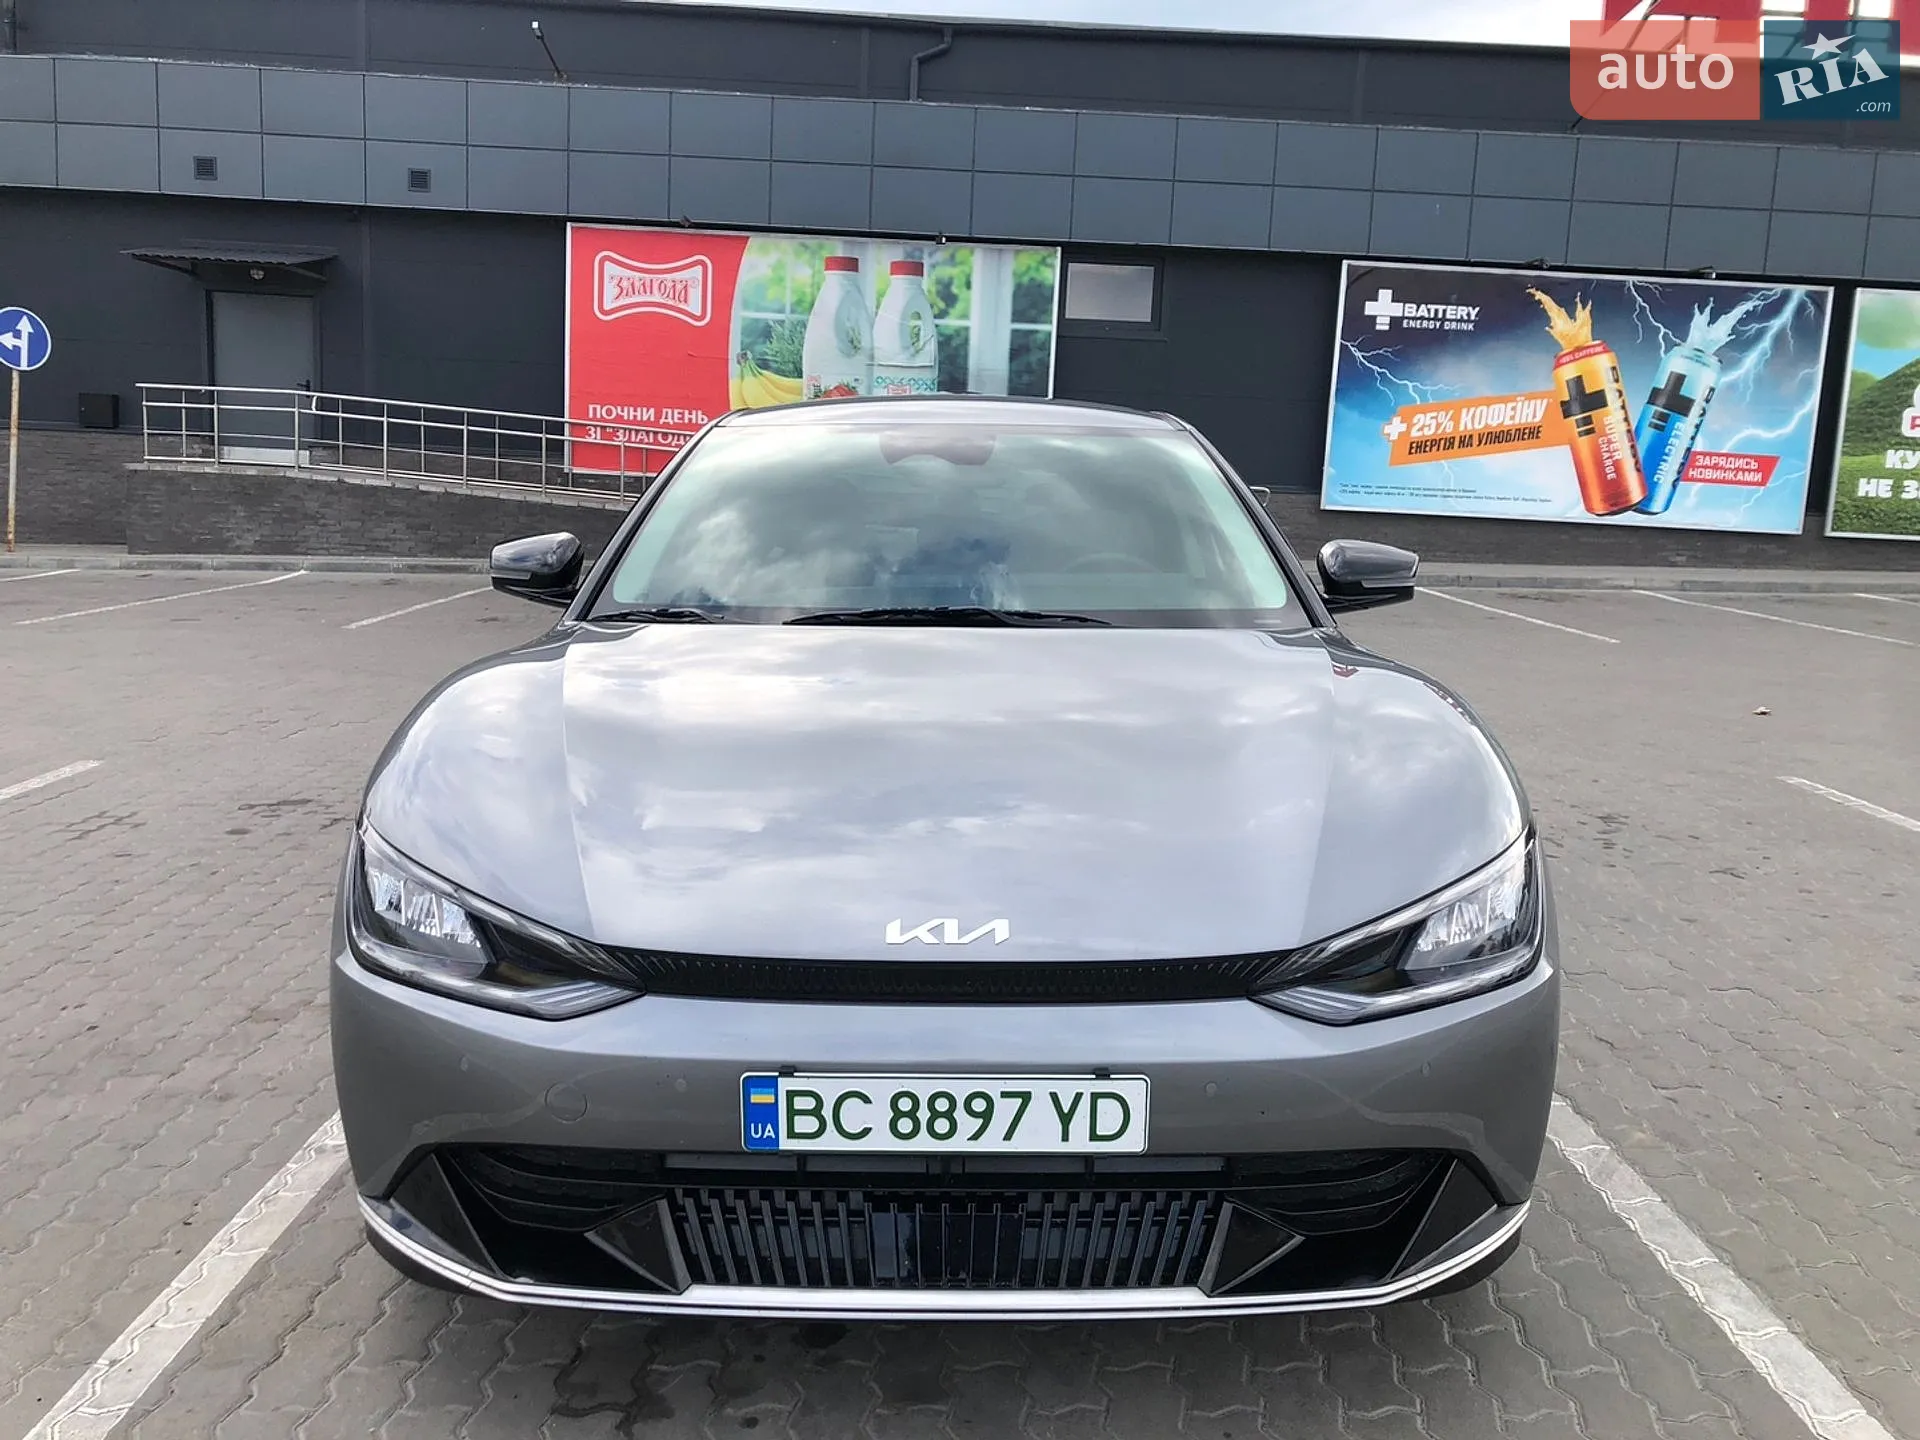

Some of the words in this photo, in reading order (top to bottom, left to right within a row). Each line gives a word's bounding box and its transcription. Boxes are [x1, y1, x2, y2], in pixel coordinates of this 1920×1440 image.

[1403, 303, 1480, 320] BATTERY
[1402, 319, 1442, 330] ENERGY
[1444, 321, 1475, 331] DRINK
[588, 404, 656, 421] ПОЧНИ
[659, 408, 709, 425] ДЕНЬ
[1410, 409, 1456, 437] 25%
[584, 425, 602, 441] ЗІ
[1408, 437, 1456, 456] ЕНЕРГІЯ
[1458, 434, 1474, 449] НА
[1477, 425, 1543, 447] УЛЮБЛЕНЕ
[1603, 415, 1623, 461] SUPER
[1597, 437, 1617, 480] CHARGE
[1653, 421, 1687, 485] ELECTRIC
[1695, 455, 1759, 469] ЗАРЯДИСЬ
[1688, 468, 1763, 482] НОВИНКАМИ
[1857, 478, 1894, 498] НЕ
[885, 918, 1010, 945] KIA
[785, 1089, 874, 1141] BC
[888, 1090, 1033, 1142] 8897
[1048, 1091, 1132, 1143] YD
[750, 1123, 776, 1140] UA
